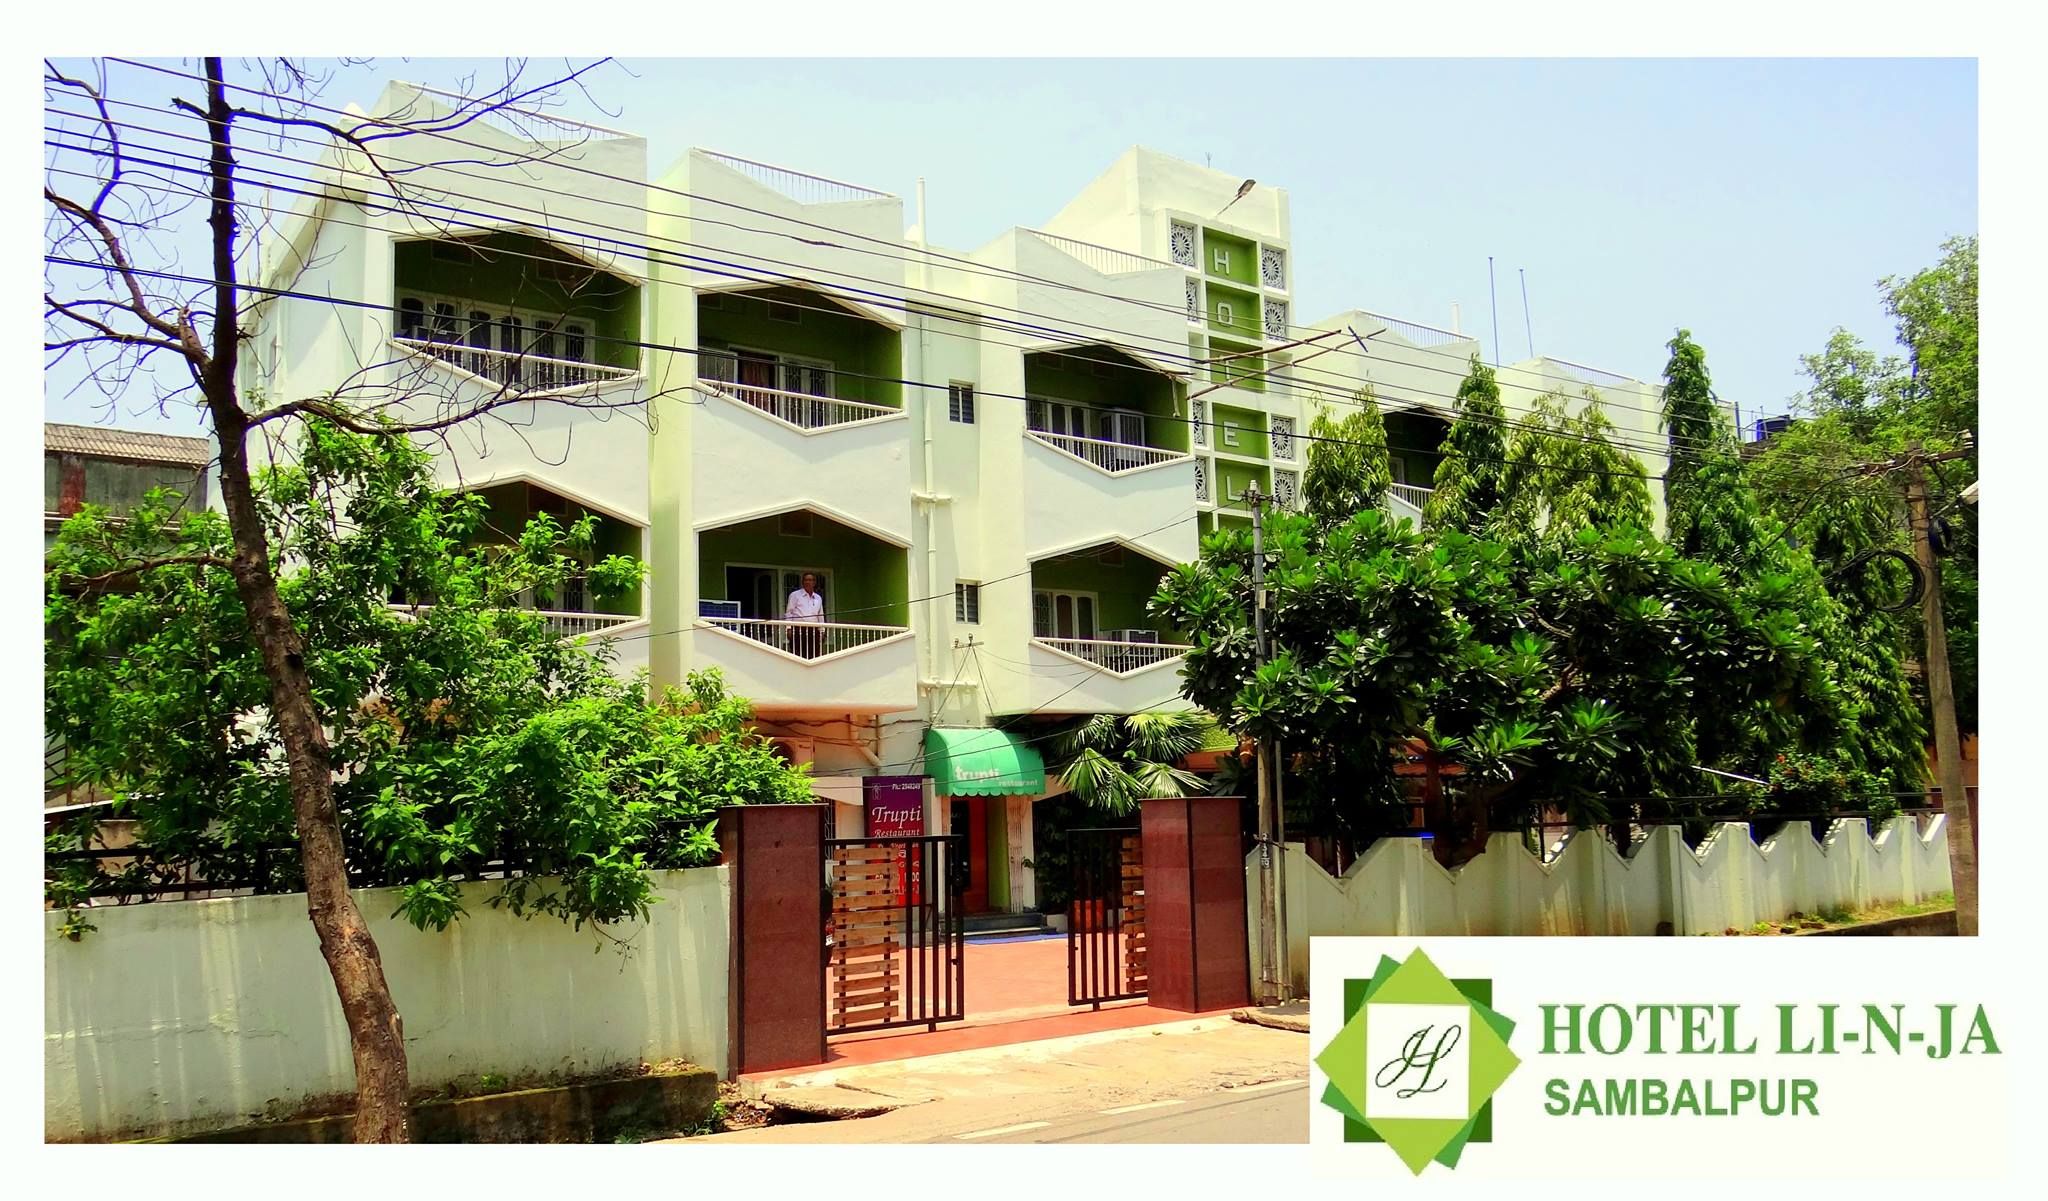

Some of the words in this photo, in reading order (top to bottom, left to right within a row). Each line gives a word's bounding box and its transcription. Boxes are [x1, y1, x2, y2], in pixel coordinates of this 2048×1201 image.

[1213, 247, 1243, 501] HOTEL
[955, 766, 999, 784] trupti
[872, 805, 922, 829] Trupti
[874, 828, 921, 838] Restaurant
